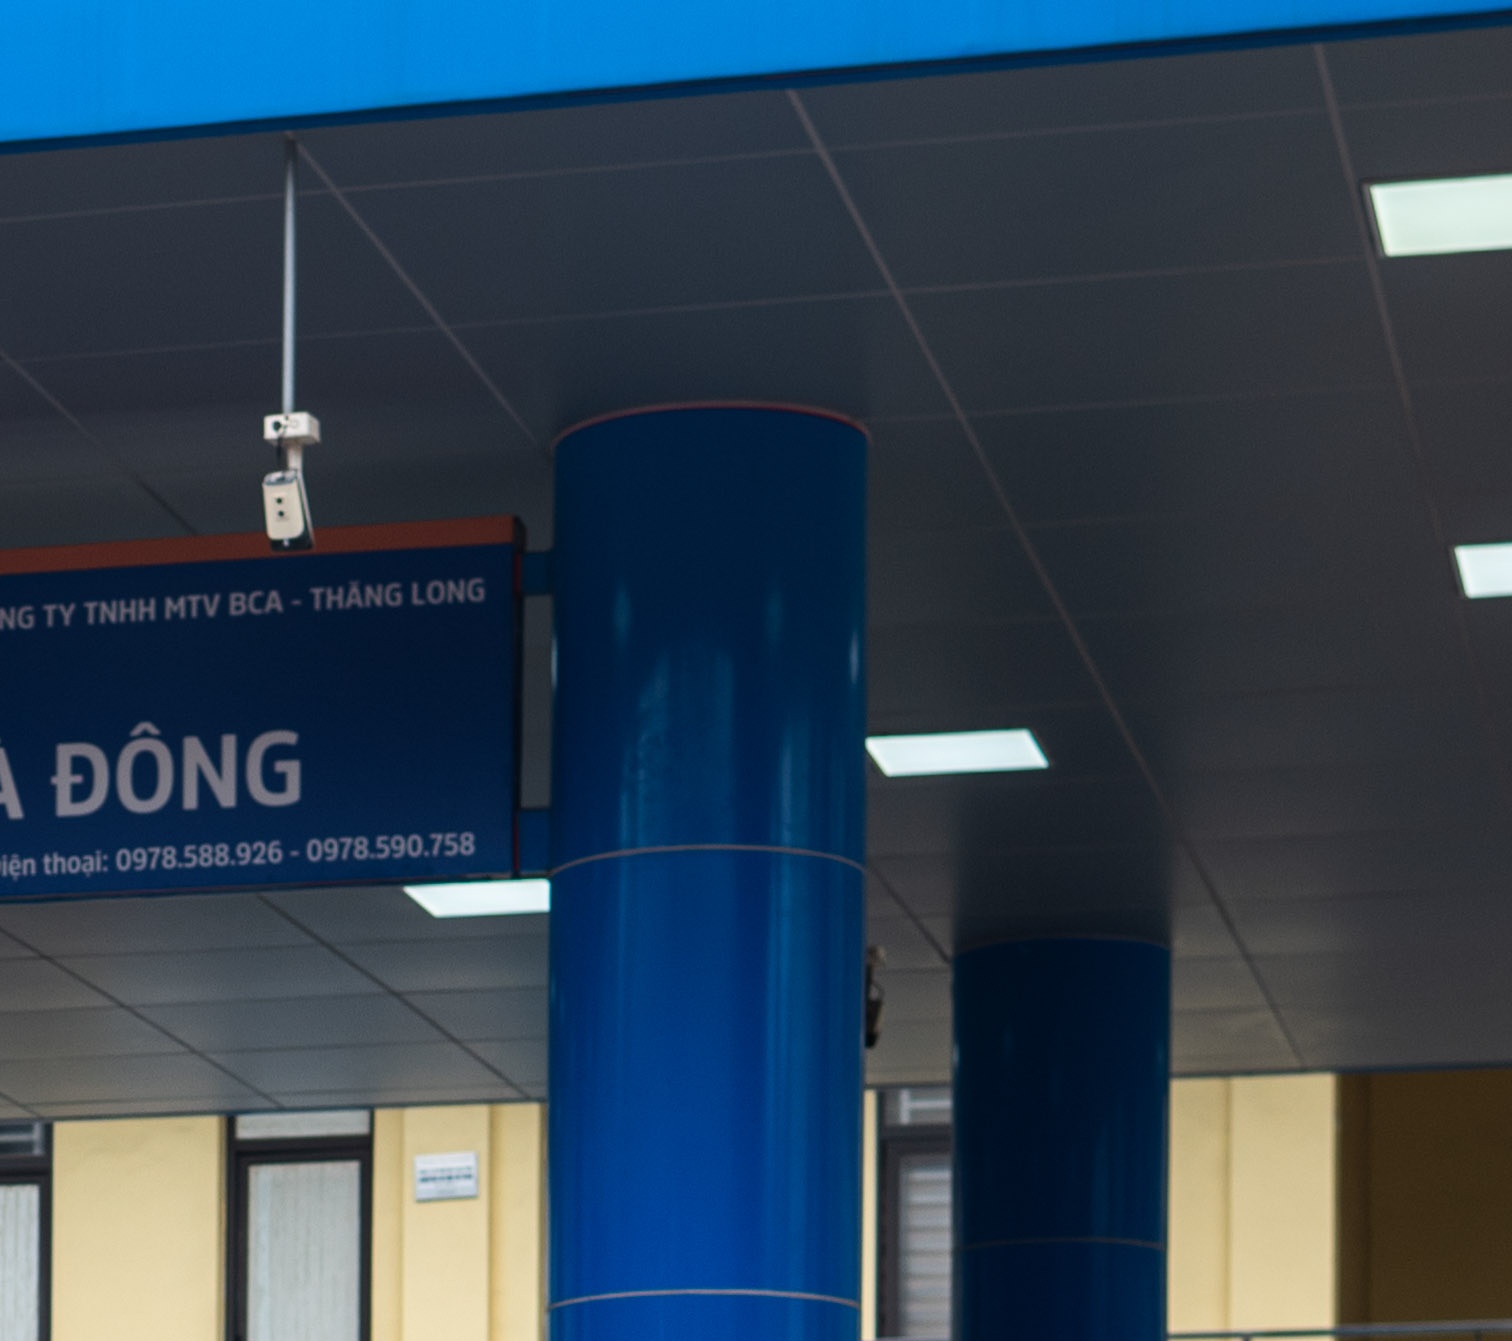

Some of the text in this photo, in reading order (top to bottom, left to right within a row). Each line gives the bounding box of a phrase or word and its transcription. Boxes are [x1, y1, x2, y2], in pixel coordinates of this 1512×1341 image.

[43, 603, 75, 627] TY
[84, 598, 156, 624] TNHH
[165, 593, 220, 620] MTV
[229, 590, 283, 616] BCA
[310, 581, 402, 610] THĂNG
[412, 578, 485, 605] LONG
[50, 721, 301, 817] ĐÔNG
[42, 849, 108, 877] thoại:
[115, 840, 283, 871] 0978.588.926
[306, 832, 475, 862] 0978.590.758
